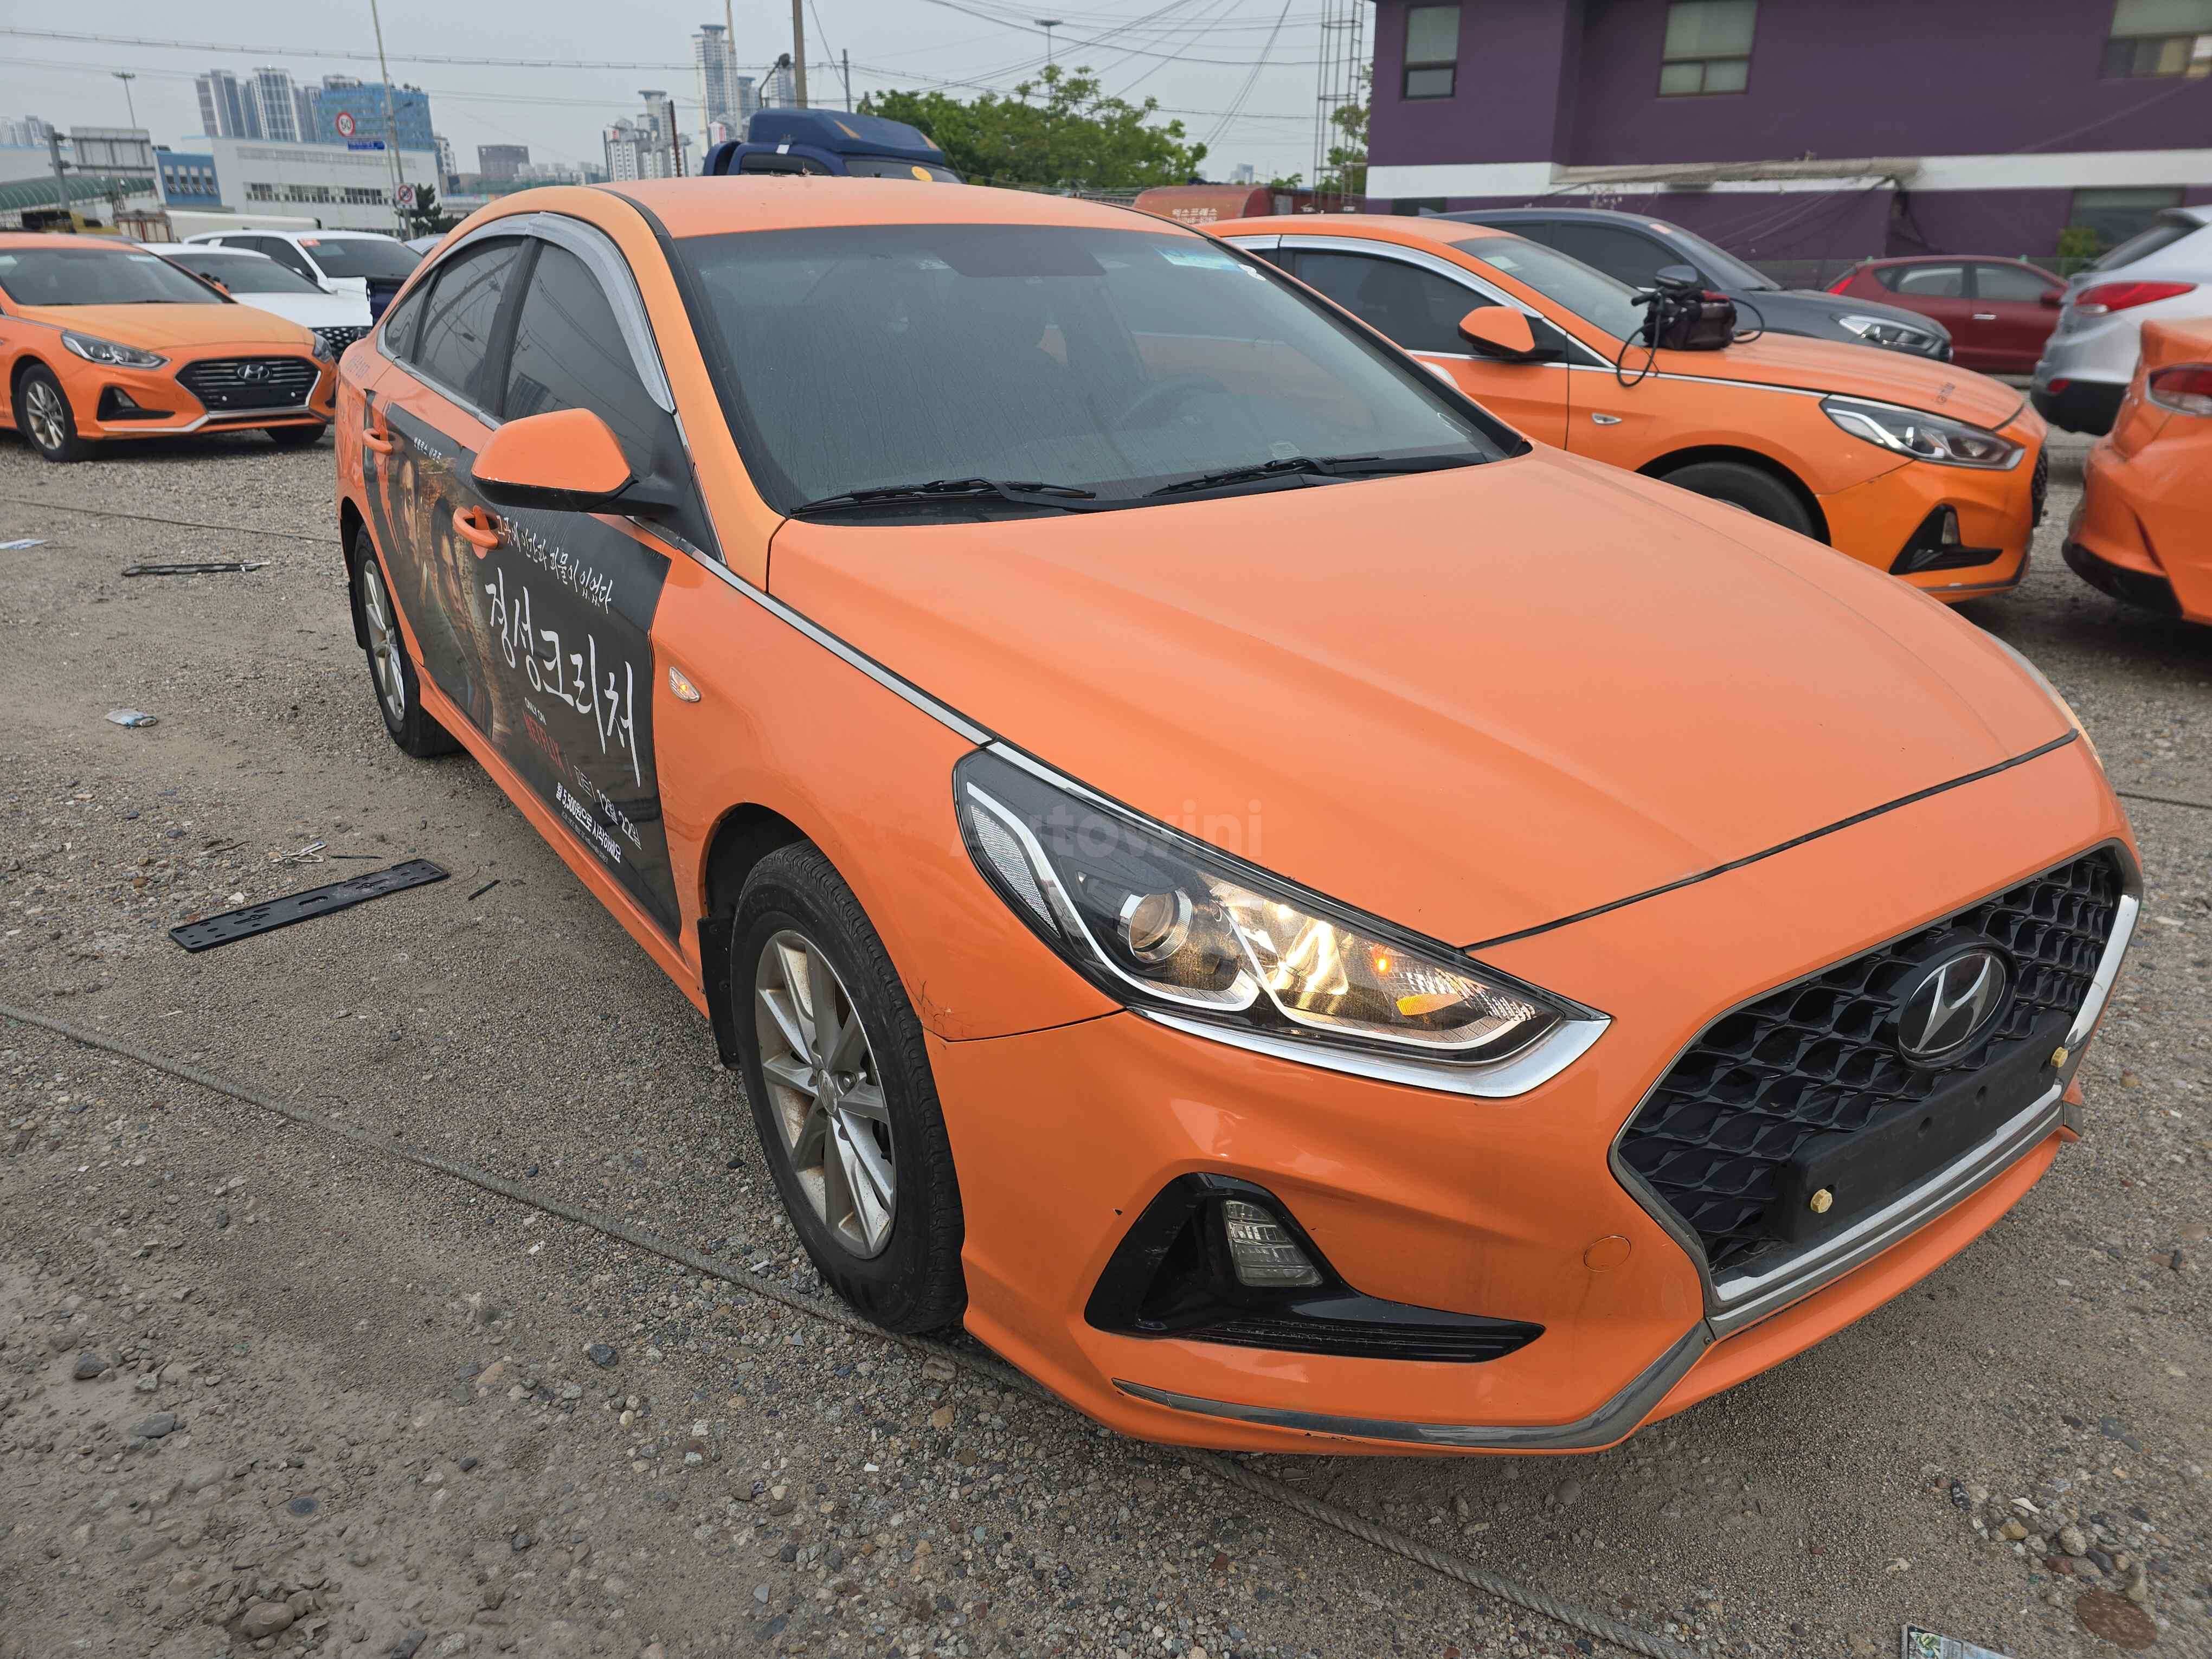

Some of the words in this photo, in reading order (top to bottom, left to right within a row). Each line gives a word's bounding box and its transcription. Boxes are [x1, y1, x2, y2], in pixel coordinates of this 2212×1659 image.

[522, 528, 547, 571] 인간과
[550, 546, 580, 593] 괴물이
[579, 567, 613, 614] 있었다
[485, 567, 640, 787] 경성크리처
[556, 782, 563, 801] 월
[562, 788, 592, 832] 5,500원으로
[592, 820, 621, 863] 시작하세요
[596, 789, 619, 825] 12월
[619, 811, 642, 850] 22일
